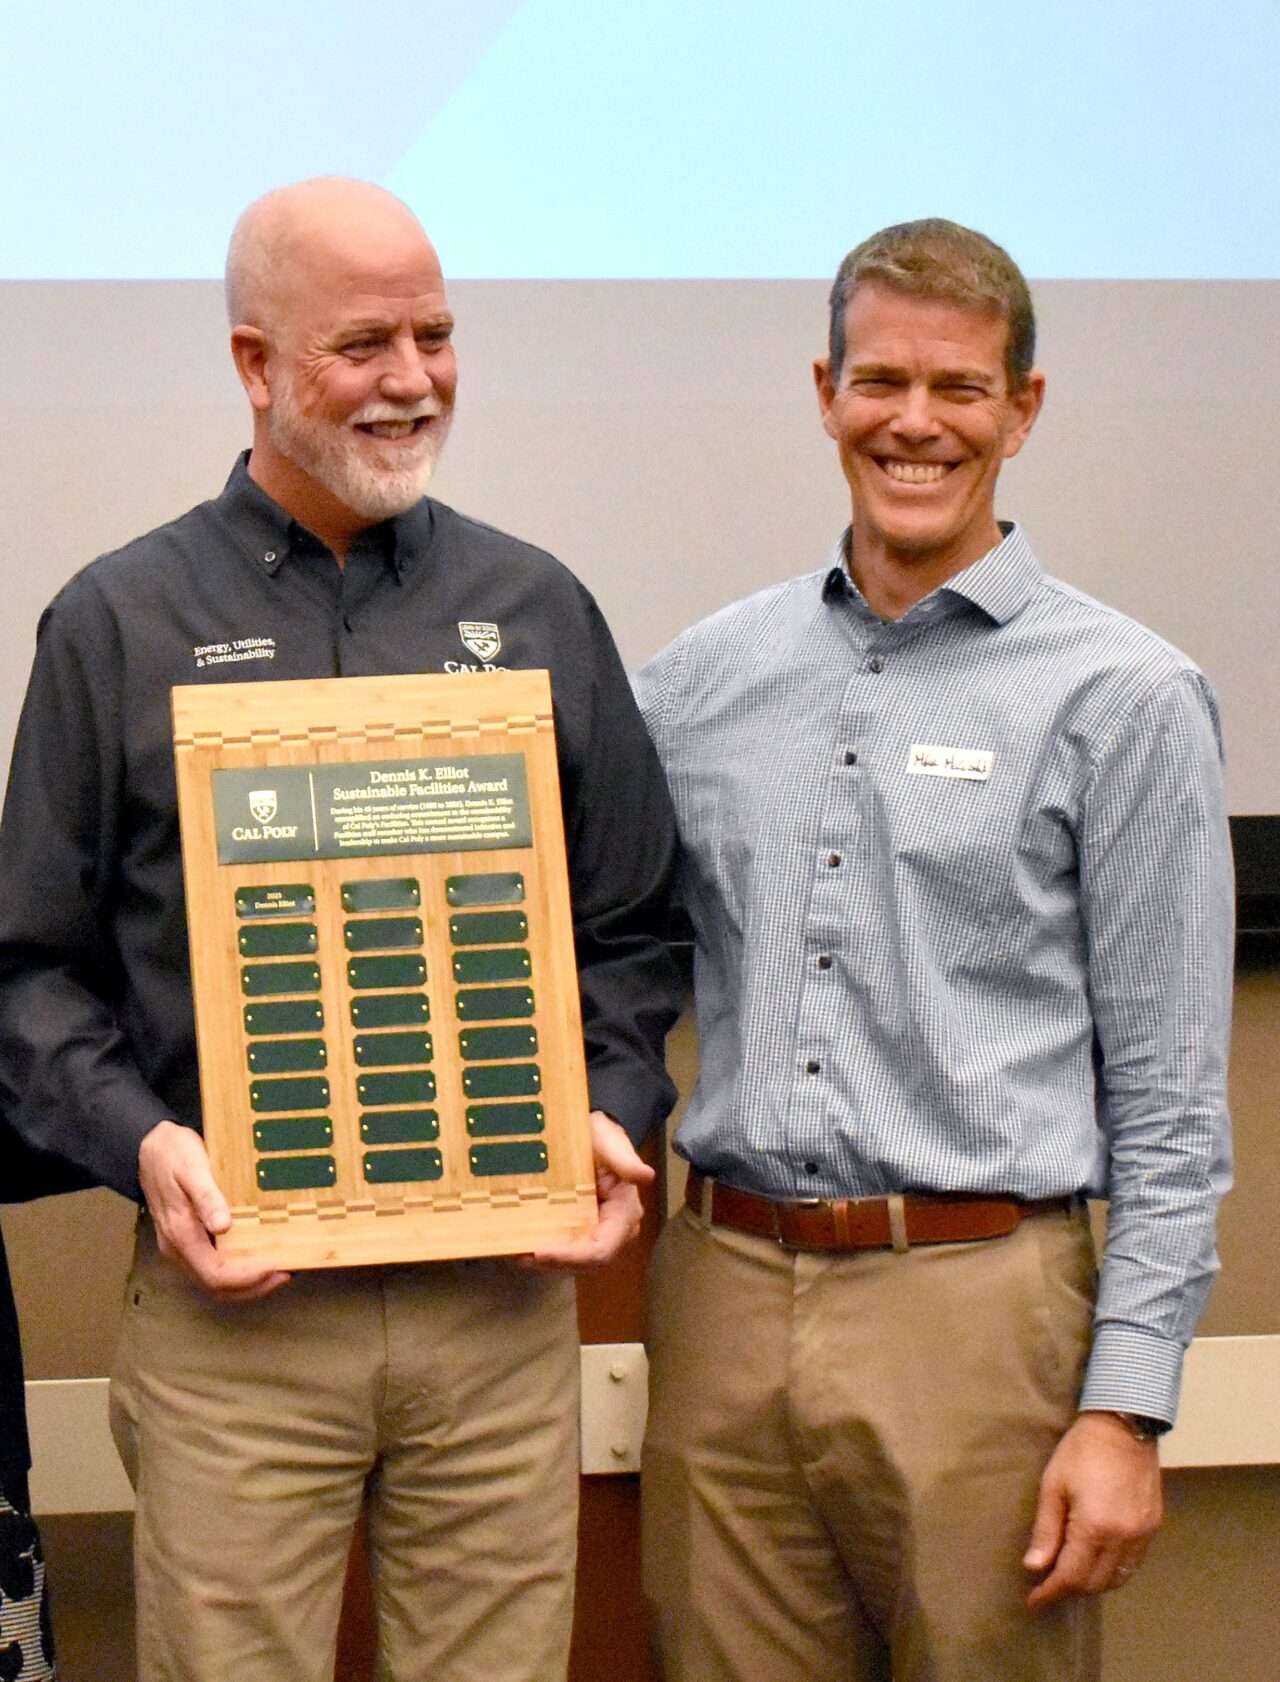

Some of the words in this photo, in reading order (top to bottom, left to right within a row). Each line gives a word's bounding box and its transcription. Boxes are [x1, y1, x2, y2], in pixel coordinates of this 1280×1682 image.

[194, 643, 232, 656] Energy,
[232, 637, 276, 650] Utilities,
[196, 658, 205, 667] &
[206, 648, 275, 664] Sustainability
[370, 770, 416, 784] Dennis
[418, 768, 432, 781] K.
[435, 766, 469, 780] Elliot
[333, 784, 407, 800] Sustainable
[409, 781, 465, 797] Facilities
[467, 779, 508, 793] Award
[232, 827, 262, 841] CAL
[262, 826, 298, 840] POLY
